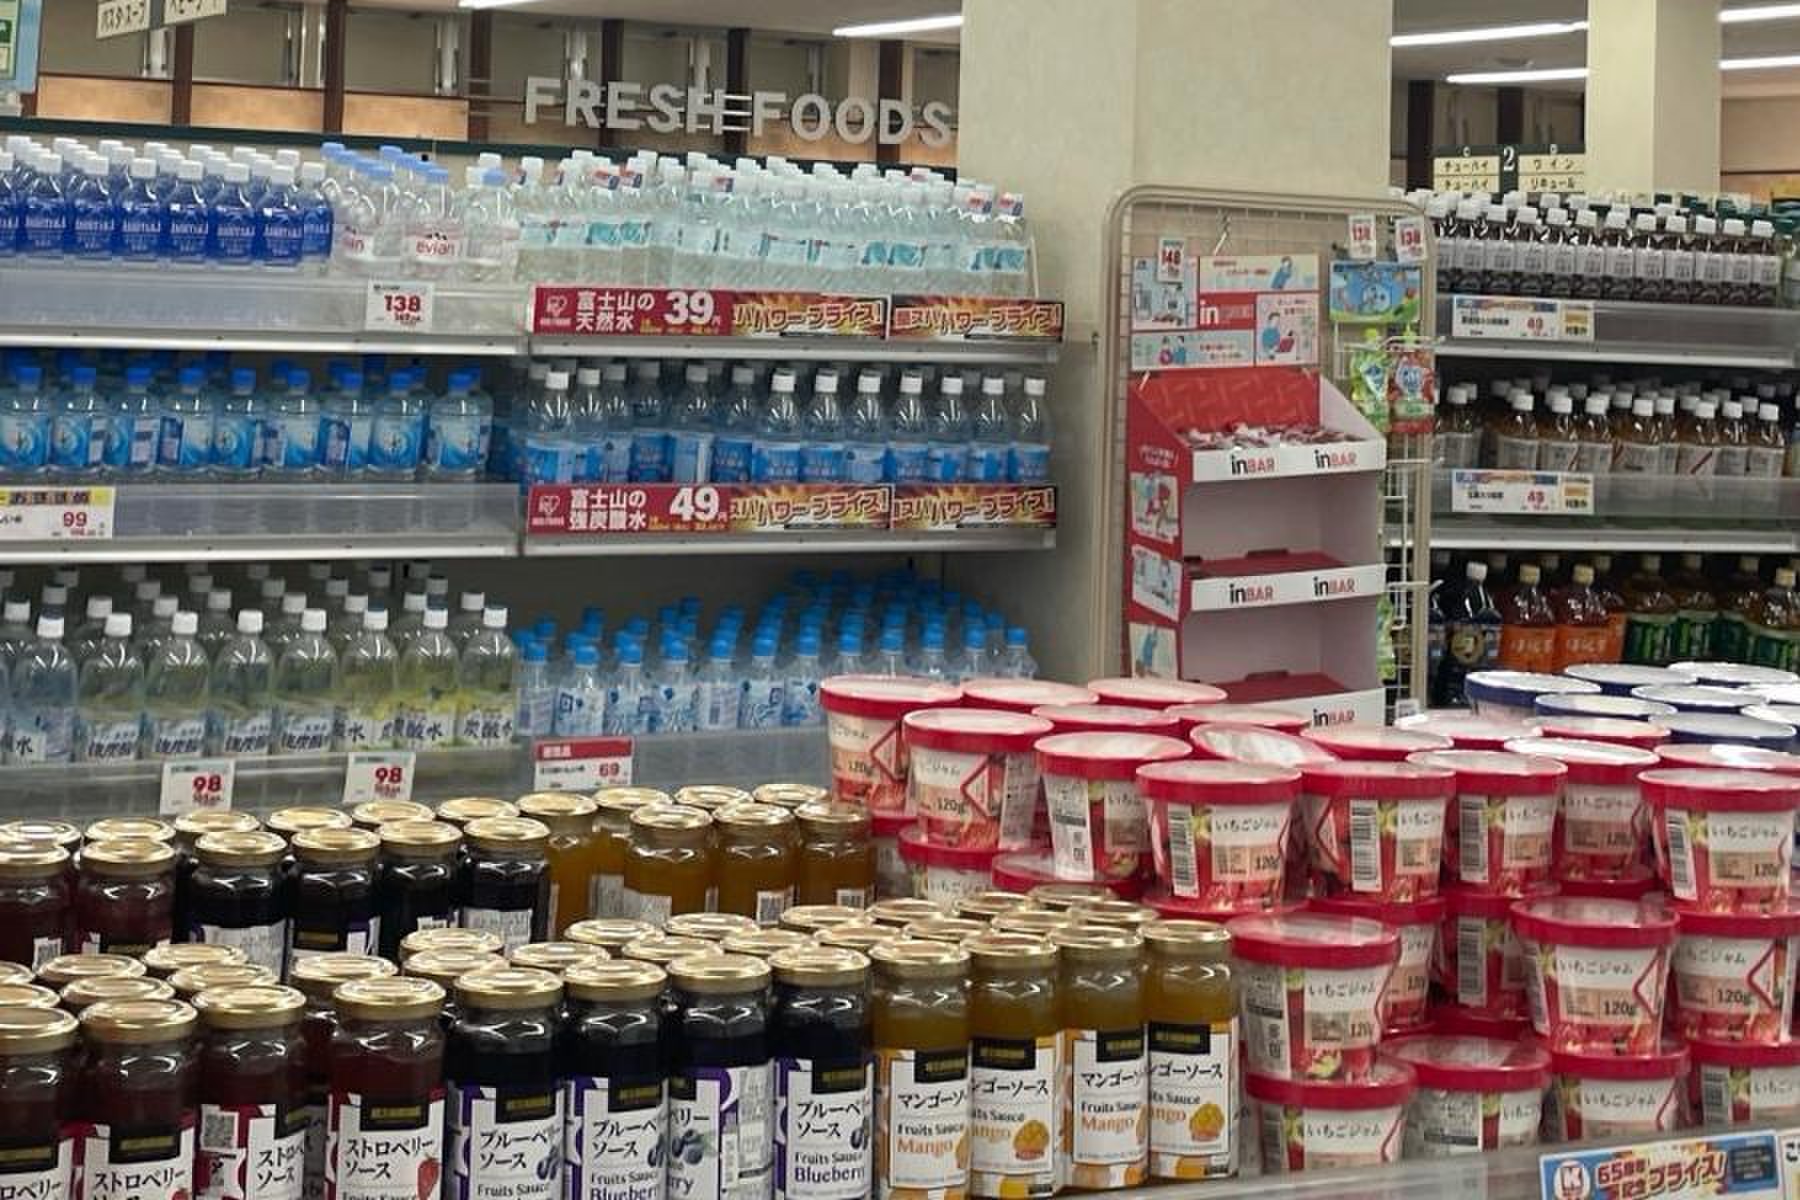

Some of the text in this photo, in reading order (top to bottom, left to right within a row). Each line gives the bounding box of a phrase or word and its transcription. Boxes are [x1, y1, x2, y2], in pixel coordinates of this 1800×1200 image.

[524, 76, 952, 148] FRESH FOODS
[1503, 145, 1515, 171] 2
[384, 295, 420, 311] 138
[664, 290, 715, 325] 39
[669, 486, 720, 522] 49
[193, 775, 222, 792] 98
[375, 766, 403, 784] 98
[796, 1122, 842, 1139] ソース
[346, 1136, 434, 1159] ストロベリー
[592, 1141, 639, 1157] ソース
[480, 1152, 527, 1170] ソース
[795, 1151, 829, 1165] Fruits
[346, 1159, 392, 1179] ソース
[95, 1167, 186, 1193] ストロベリー
